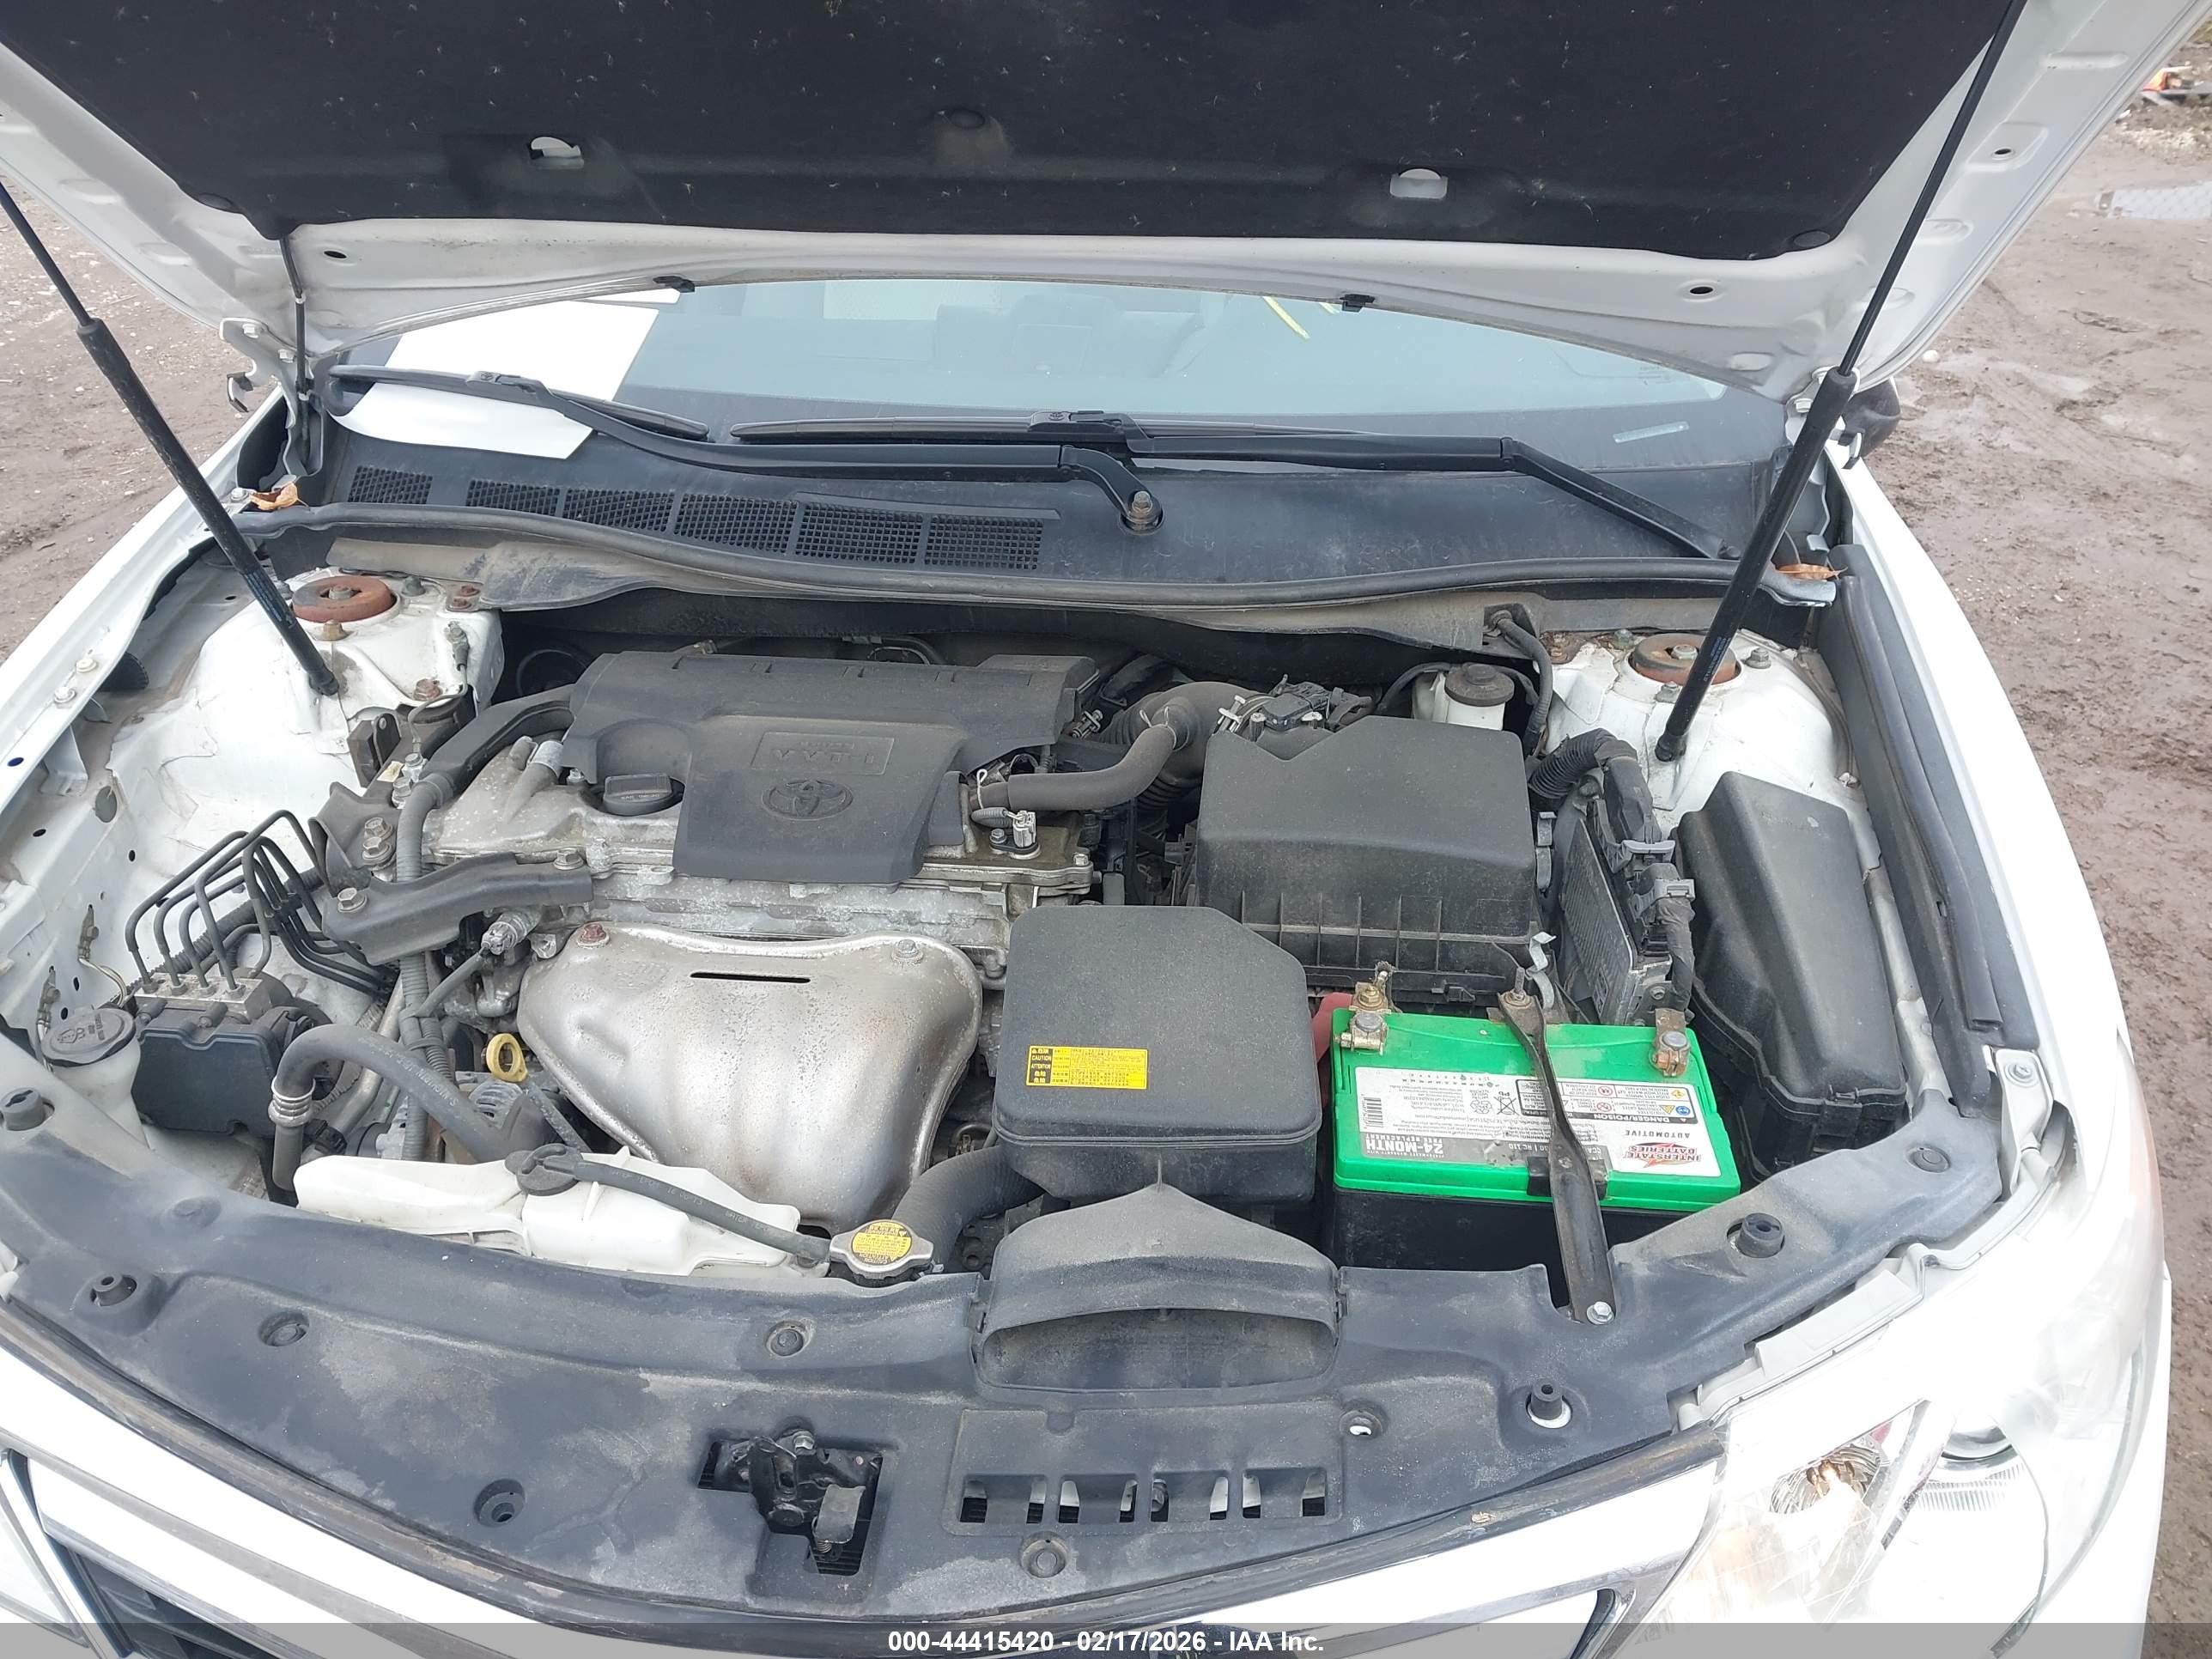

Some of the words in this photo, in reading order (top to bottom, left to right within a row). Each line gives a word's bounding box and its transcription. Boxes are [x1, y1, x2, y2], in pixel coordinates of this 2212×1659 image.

[1594, 1113, 1670, 1123] DANGER/POISON
[1365, 1133, 1420, 1143] REPLACEMENT
[1624, 1129, 1691, 1139] AUTOMOTIVE
[1365, 1139, 1443, 1155] 24-MONTH
[1628, 1145, 1697, 1156] BATTERIES
[1623, 1151, 1702, 1163] INTERSTATE
